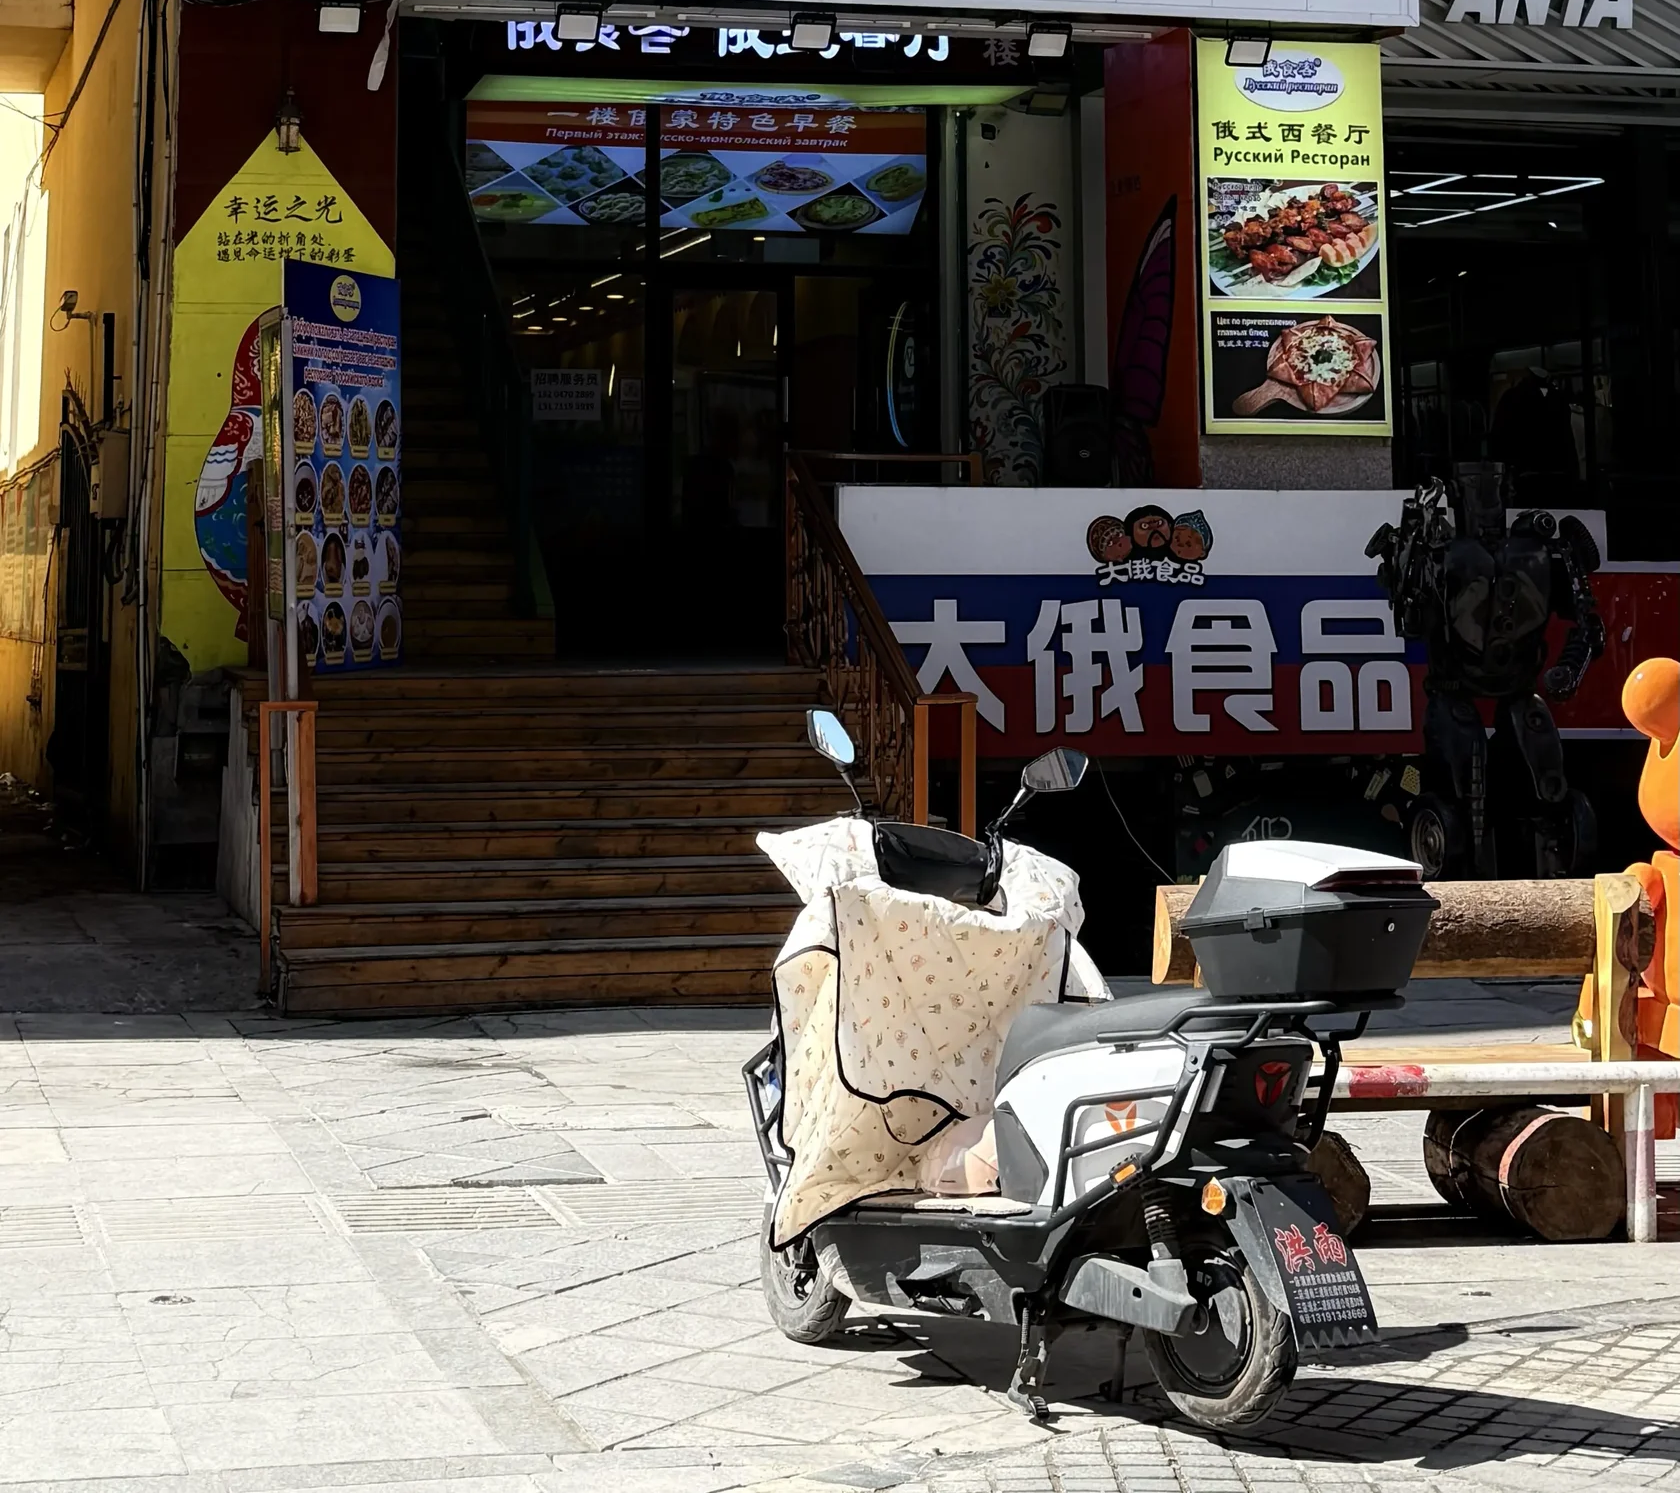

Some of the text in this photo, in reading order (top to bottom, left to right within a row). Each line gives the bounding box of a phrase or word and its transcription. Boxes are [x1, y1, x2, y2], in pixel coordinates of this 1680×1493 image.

[546, 127, 604, 140] Первый
[795, 137, 849, 149] завтрак
[1211, 120, 1371, 146] 俄式西餐厅
[1213, 146, 1371, 169] Русский Ресторан
[224, 194, 343, 224] 幸运之光
[217, 247, 357, 263] 遇见命运埋下的彩蛋
[1098, 556, 1204, 586] 大俄食品
[888, 596, 1414, 735] 大俄食品
